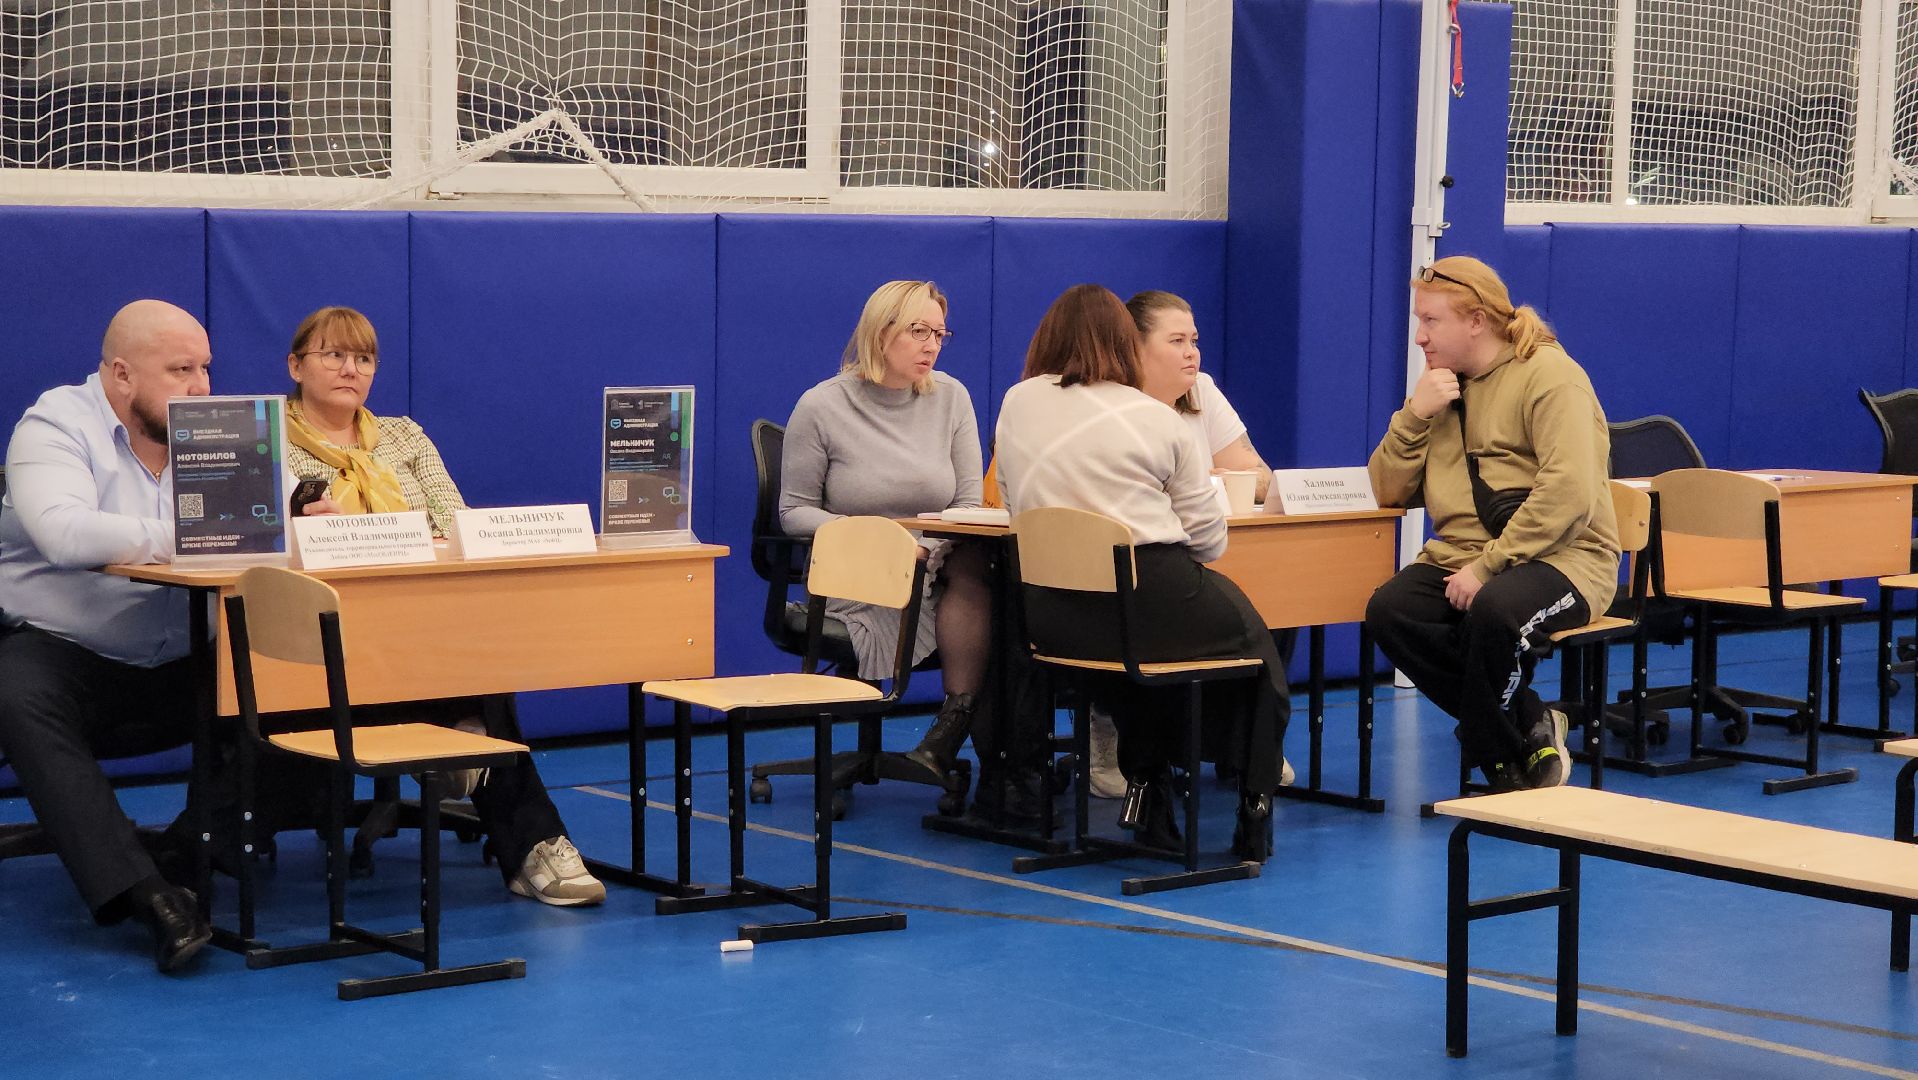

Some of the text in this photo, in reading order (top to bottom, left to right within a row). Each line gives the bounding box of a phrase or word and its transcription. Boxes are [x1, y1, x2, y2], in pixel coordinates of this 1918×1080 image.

[610, 439, 655, 447] МЕЛЬНИЧУК
[177, 452, 236, 461] МОТОВИЛОВ
[1286, 491, 1367, 502] Юлия Александровна
[325, 515, 398, 529] МОТОВИЛОВ
[489, 511, 565, 525] МЕЛЬНИЧУК
[181, 534, 222, 542] СОВМЕСТНЫЕ
[308, 529, 422, 544] Алексей Владимирович
[479, 526, 583, 539] Оксана Владимировна
